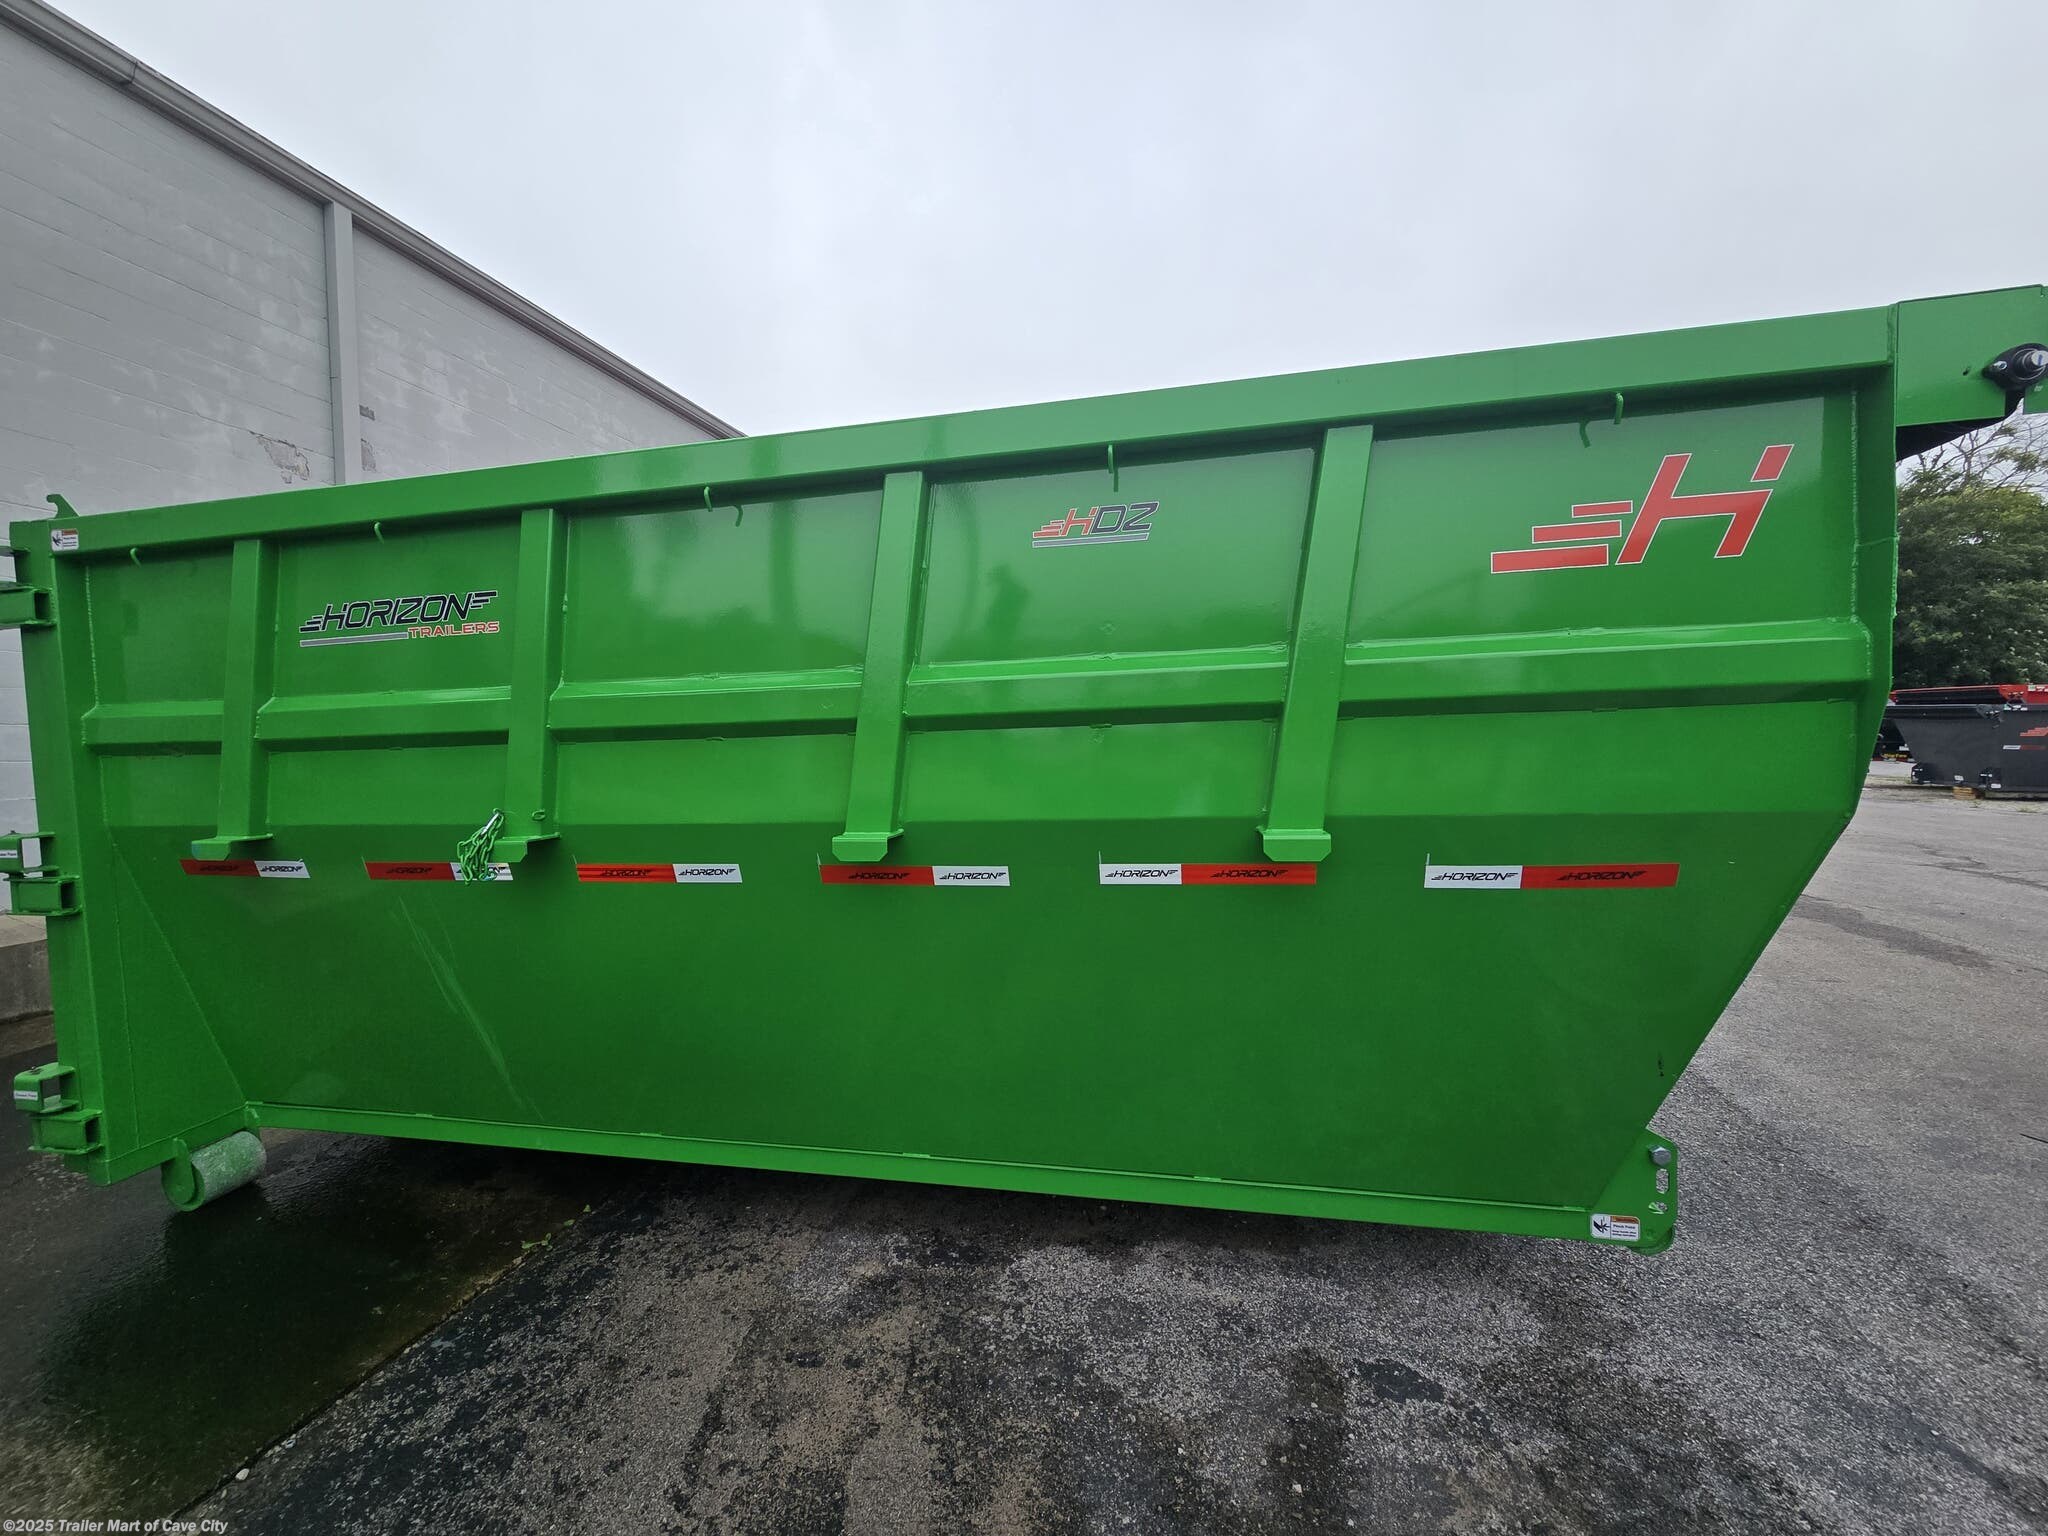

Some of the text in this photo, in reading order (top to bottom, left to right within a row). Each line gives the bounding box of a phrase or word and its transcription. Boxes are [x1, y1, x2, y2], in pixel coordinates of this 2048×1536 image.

[320, 590, 474, 632] HORIZON
[408, 620, 500, 639] TRAILERS
[264, 865, 300, 873] HORIZON
[684, 868, 730, 877] HORIZON
[1113, 869, 1279, 878] HORIZON HORIZON
[854, 872, 1000, 881] HORIZON HORIZON
[1441, 870, 1638, 881] HORIZON HORIZON
